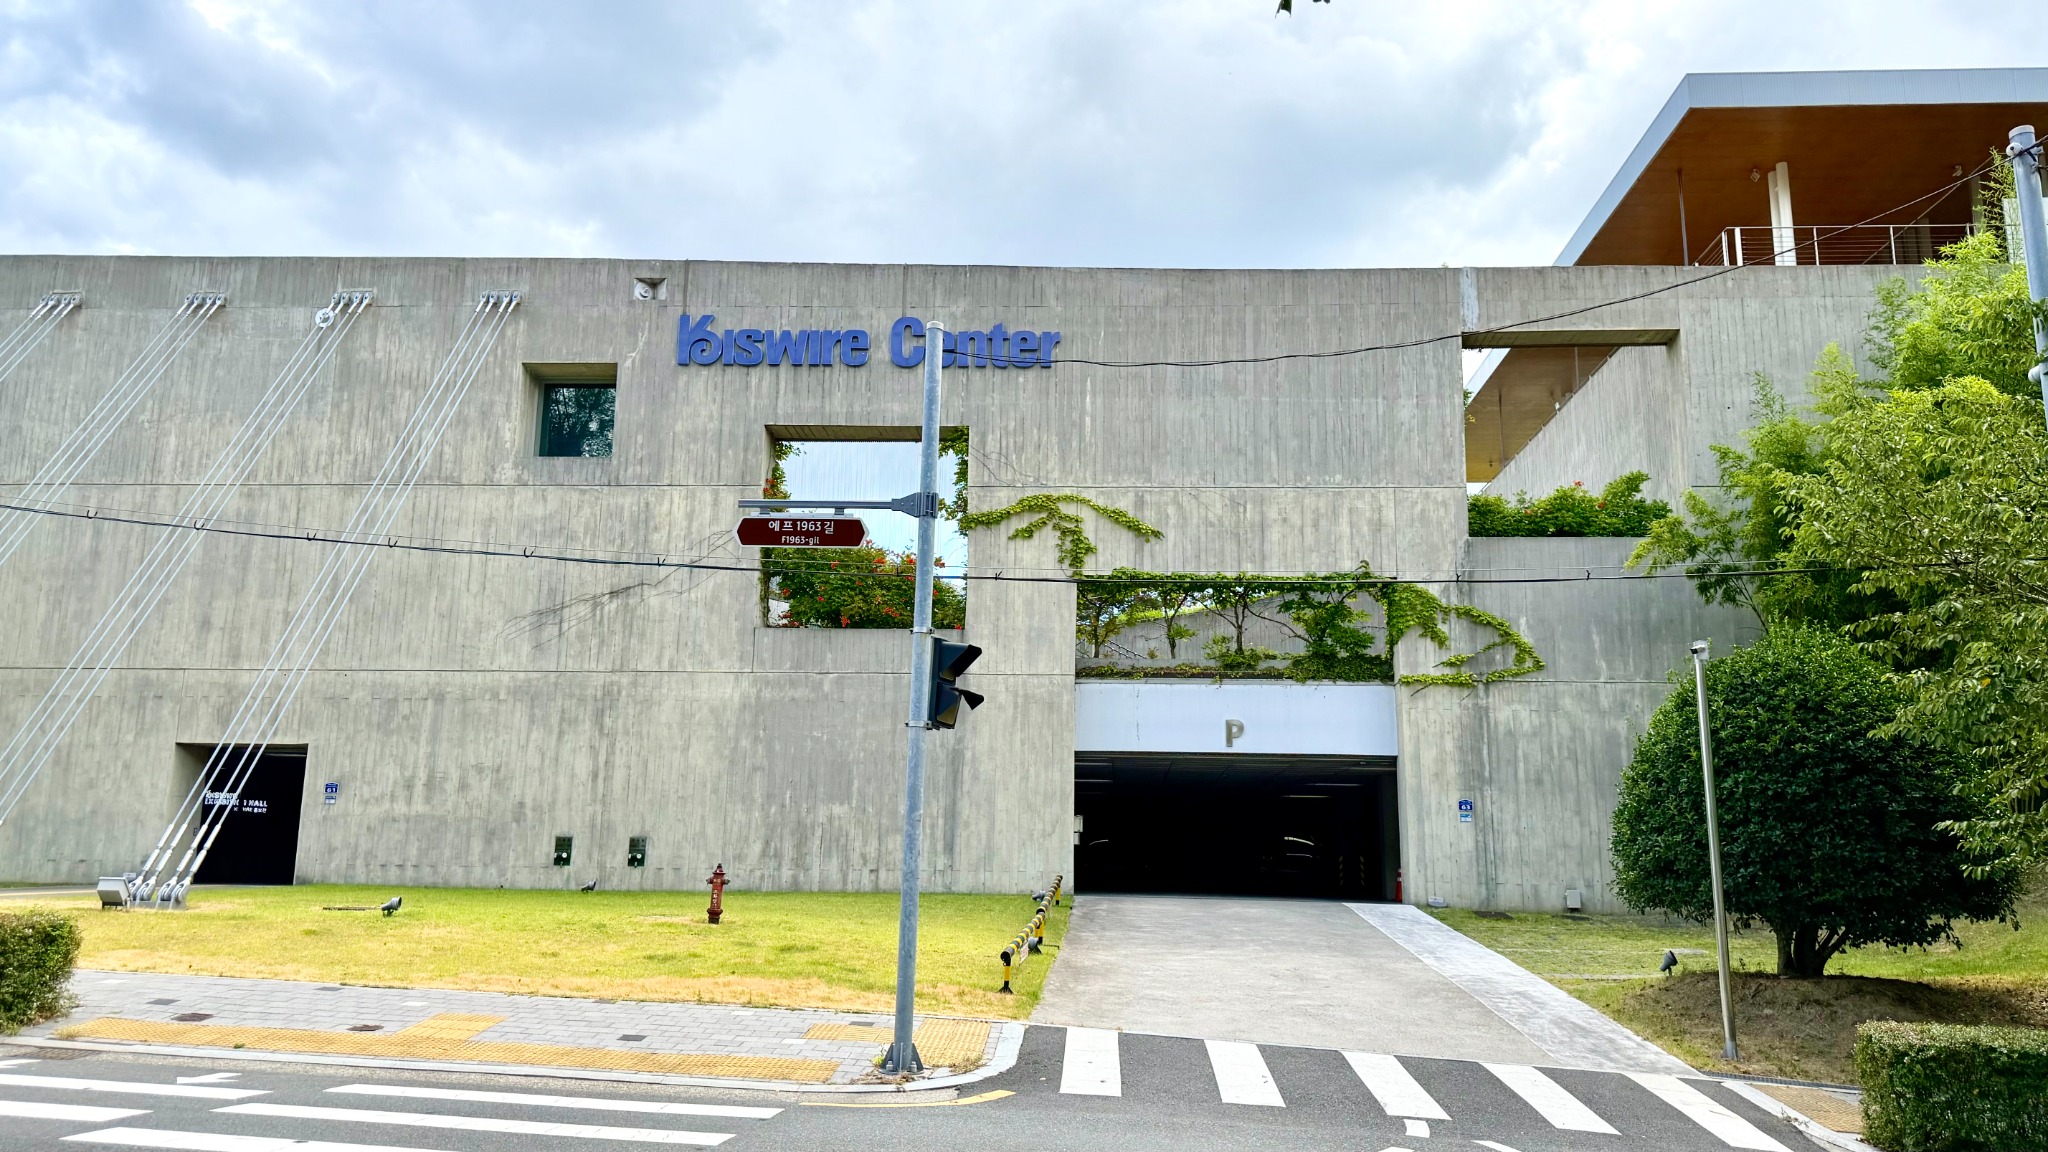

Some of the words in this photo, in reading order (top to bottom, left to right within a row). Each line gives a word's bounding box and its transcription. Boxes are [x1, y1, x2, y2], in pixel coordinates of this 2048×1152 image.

[677, 314, 870, 368] Kiswire
[781, 535, 820, 546] F1963-gil
[1225, 719, 1245, 748] P
[248, 799, 268, 807] HALL
